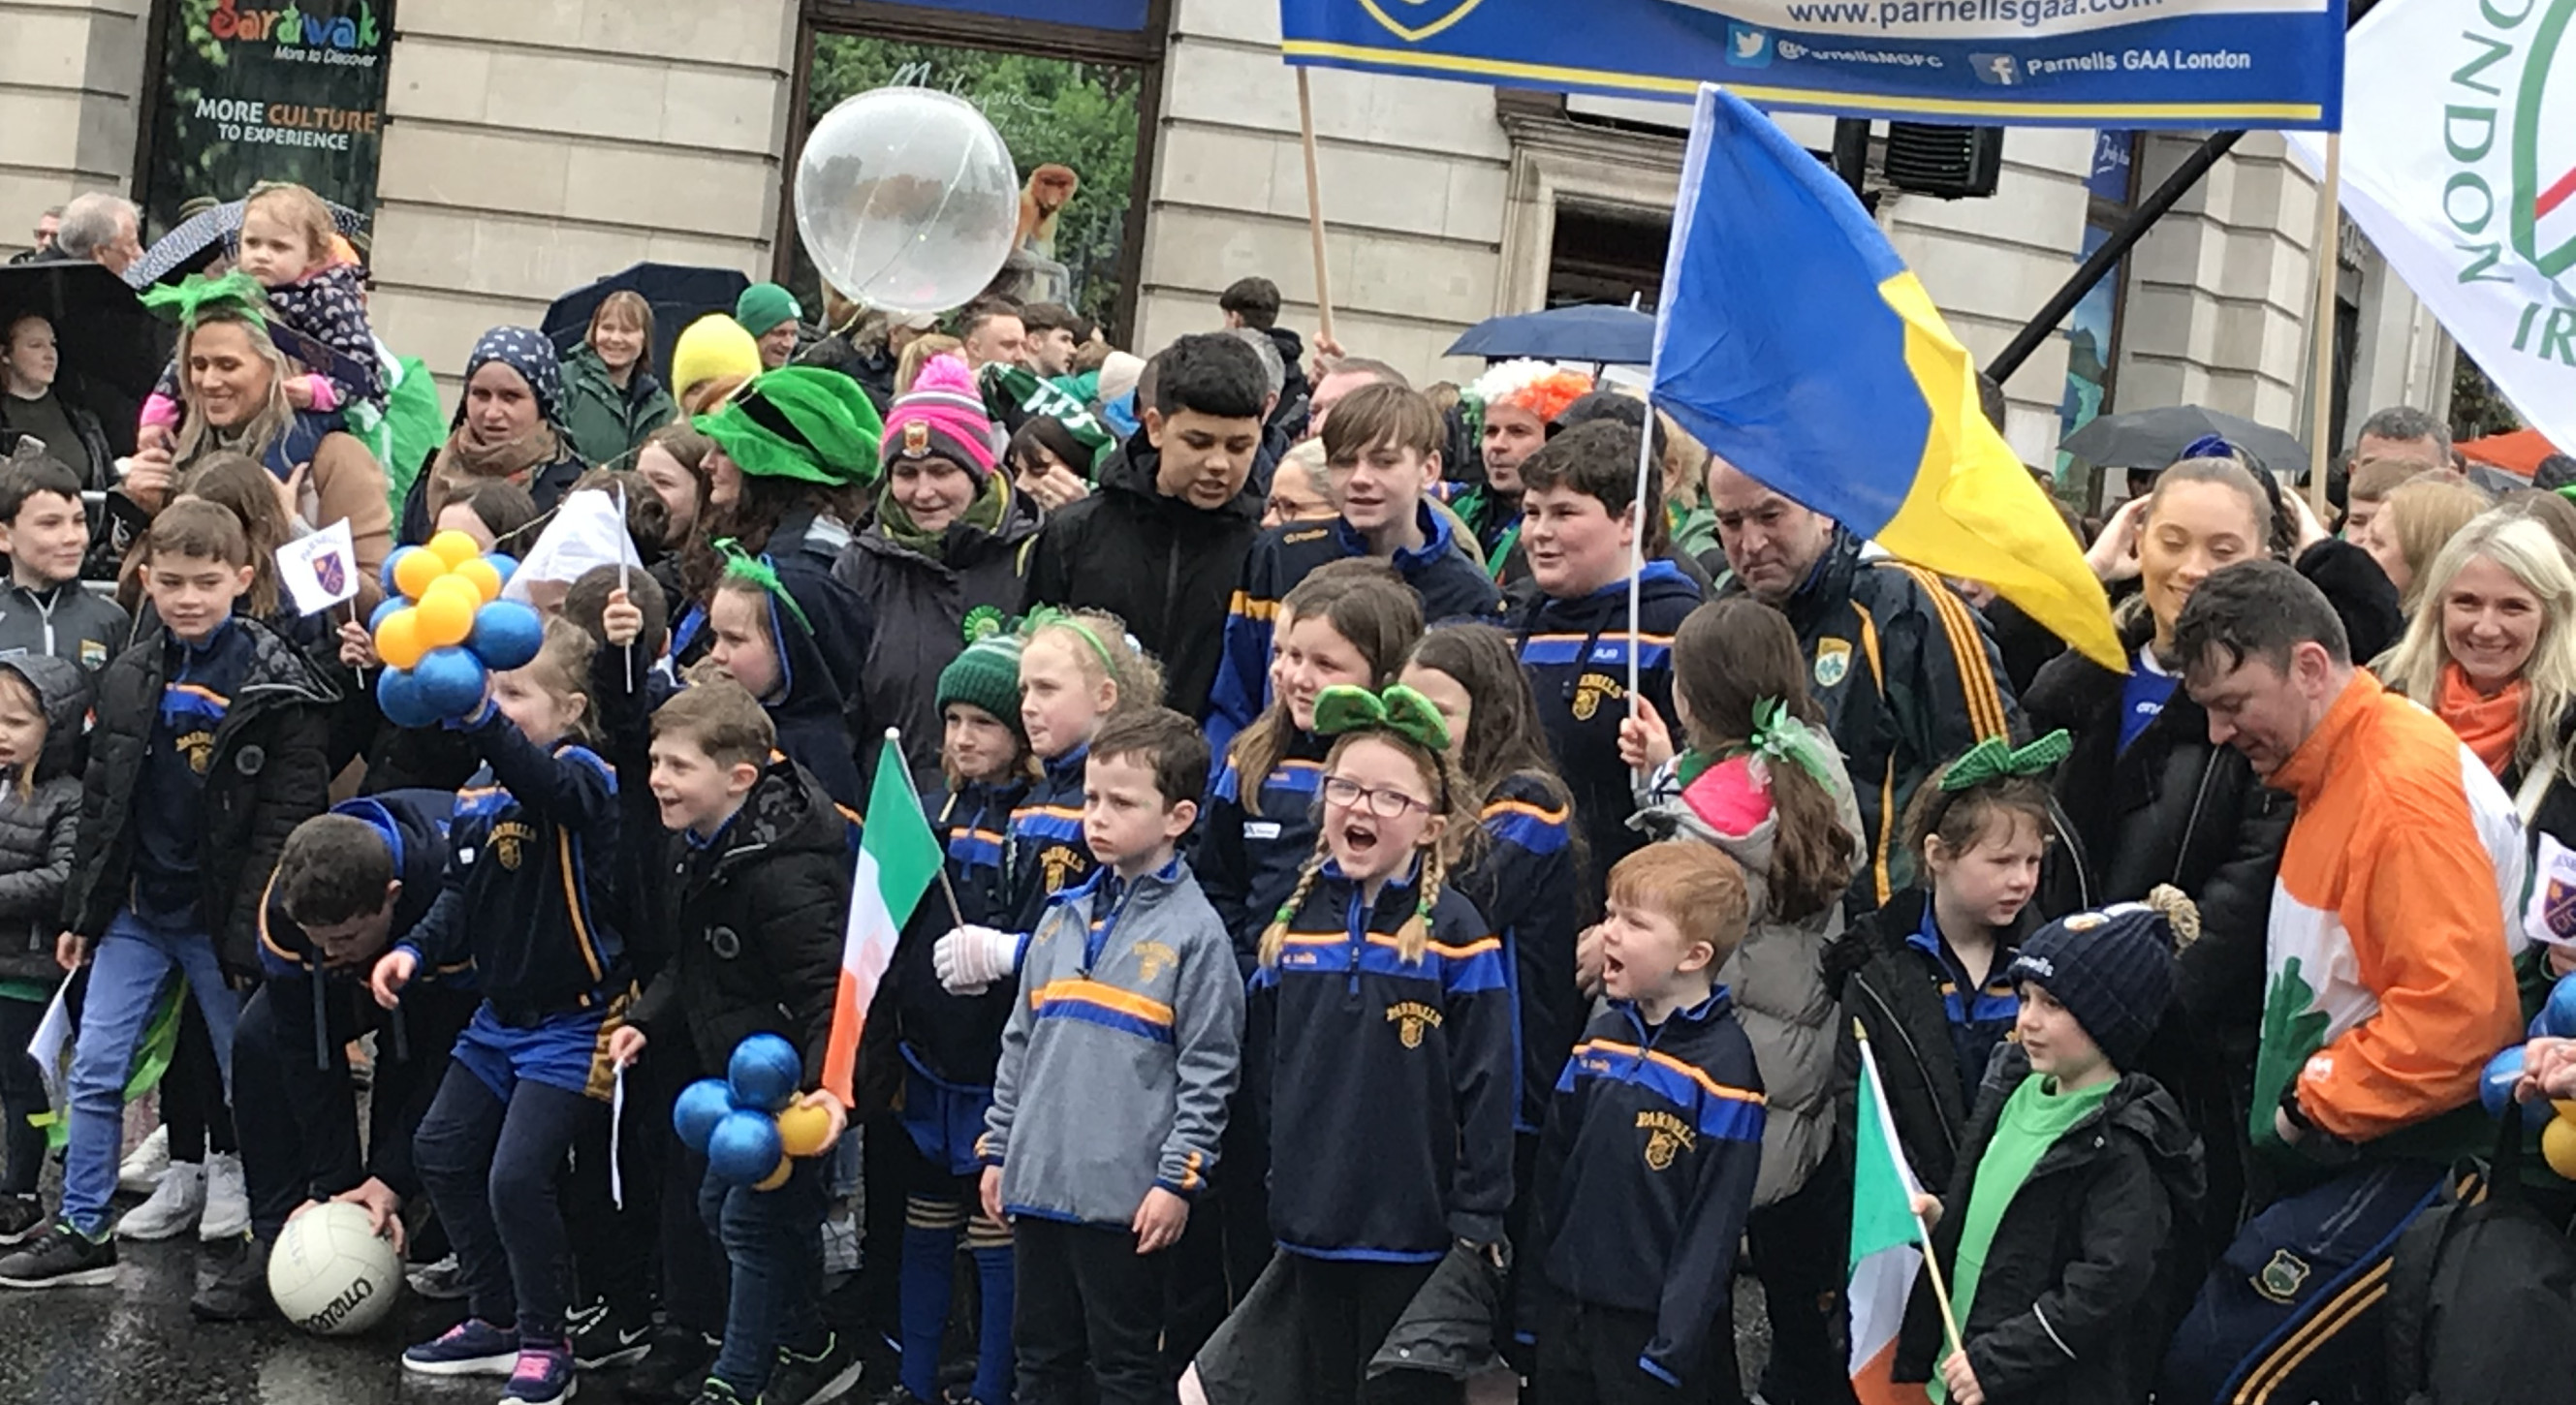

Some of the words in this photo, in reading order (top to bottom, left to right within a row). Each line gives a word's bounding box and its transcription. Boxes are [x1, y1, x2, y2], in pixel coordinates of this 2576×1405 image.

[274, 46, 306, 61] More
[307, 48, 322, 64] to
[324, 49, 378, 67] Discover
[2026, 51, 2118, 77] Parnells
[2122, 51, 2170, 71] GAA
[2175, 49, 2251, 71] London
[195, 98, 265, 123] MORE
[267, 104, 378, 133] CULTURE
[217, 123, 241, 141] TO
[244, 126, 349, 150] EXPERIENCE
